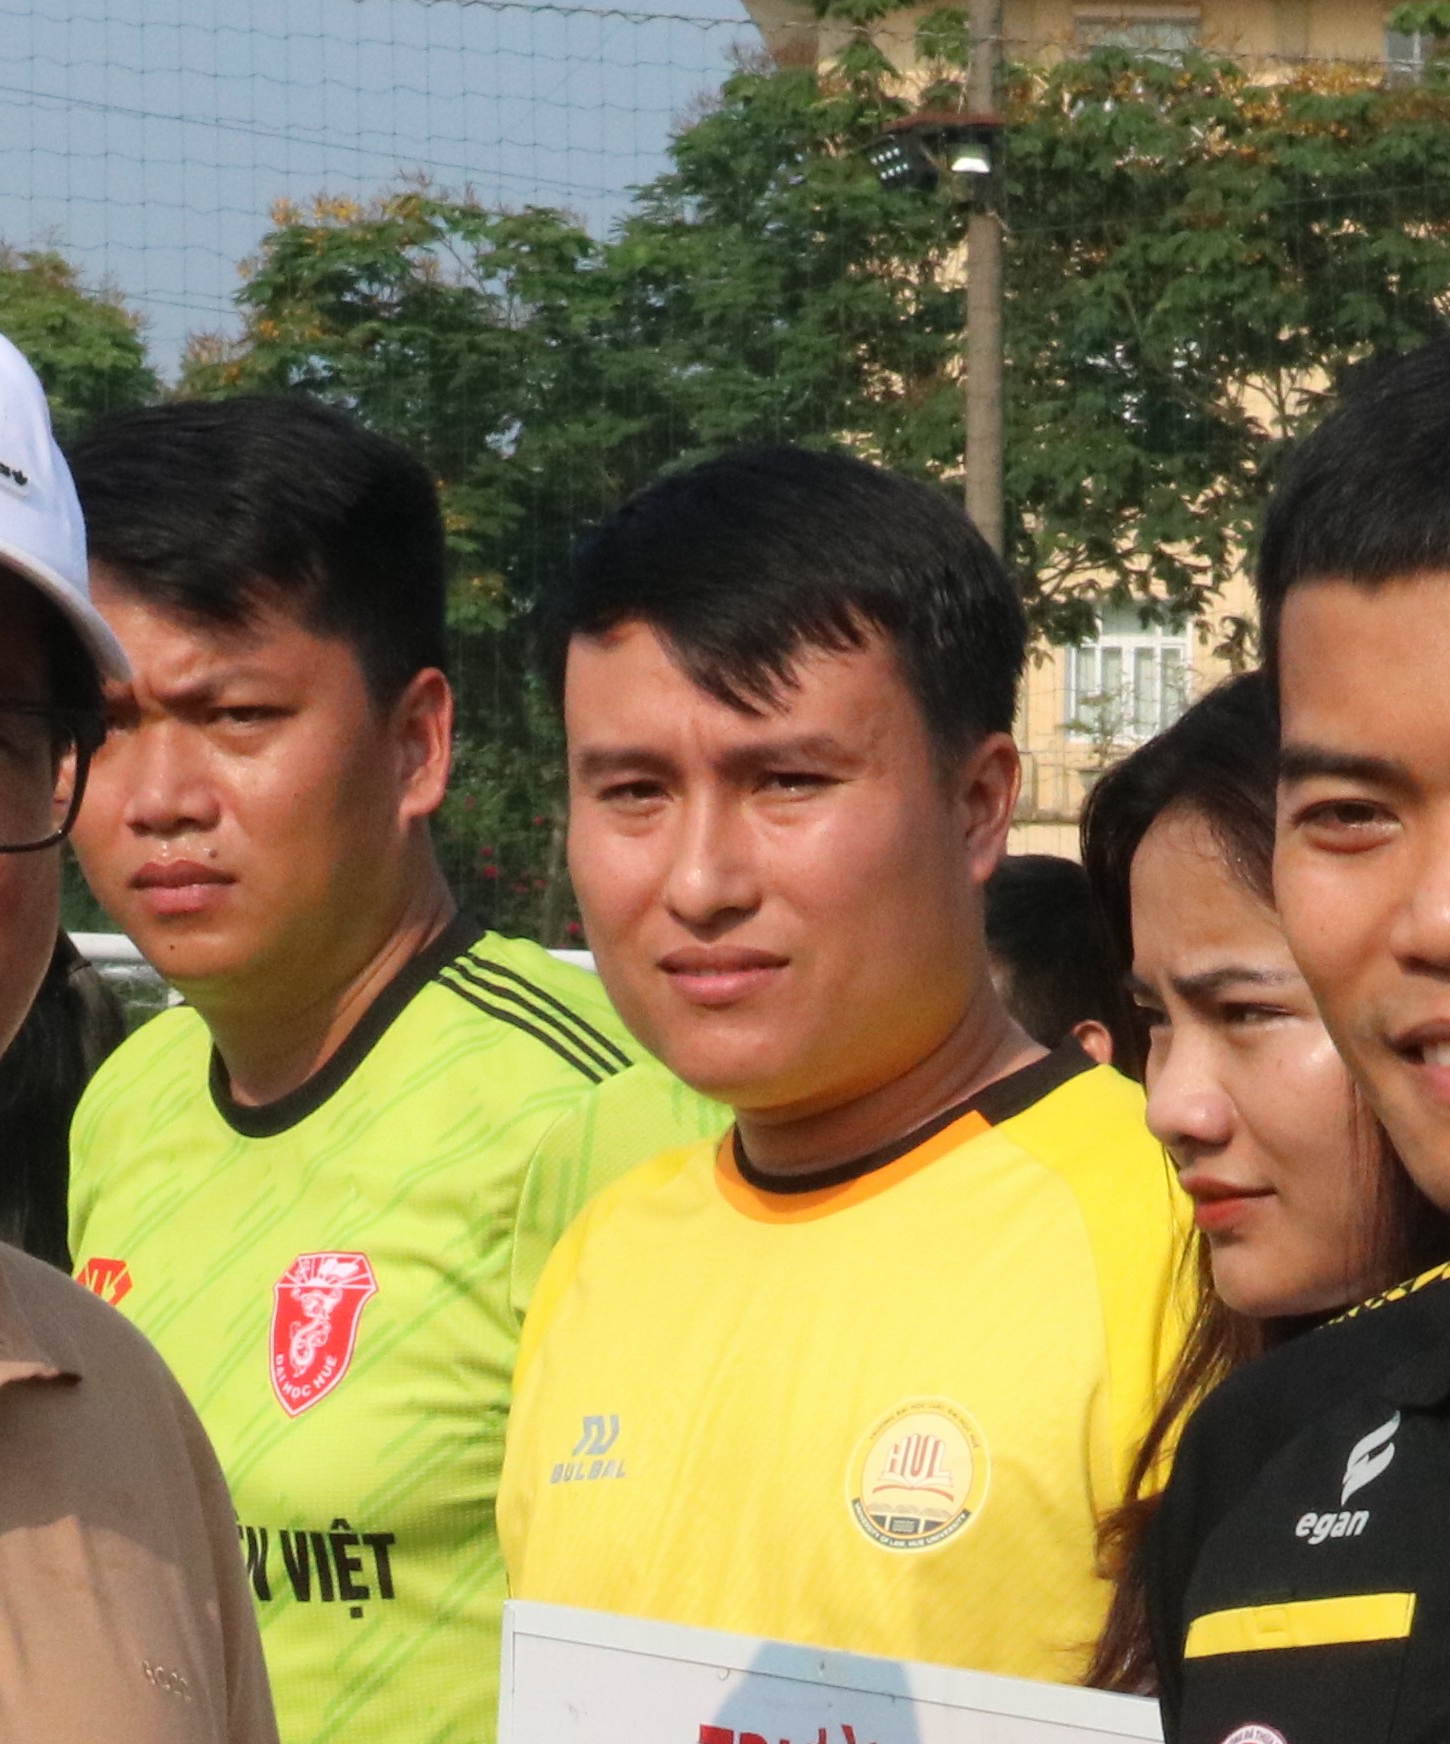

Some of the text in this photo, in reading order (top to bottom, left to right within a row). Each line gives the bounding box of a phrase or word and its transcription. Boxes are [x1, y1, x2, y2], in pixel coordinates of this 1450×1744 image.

[885, 1432, 952, 1481] HUL
[1295, 1510, 1371, 1546] egan
[279, 1518, 396, 1619] VIỆT
